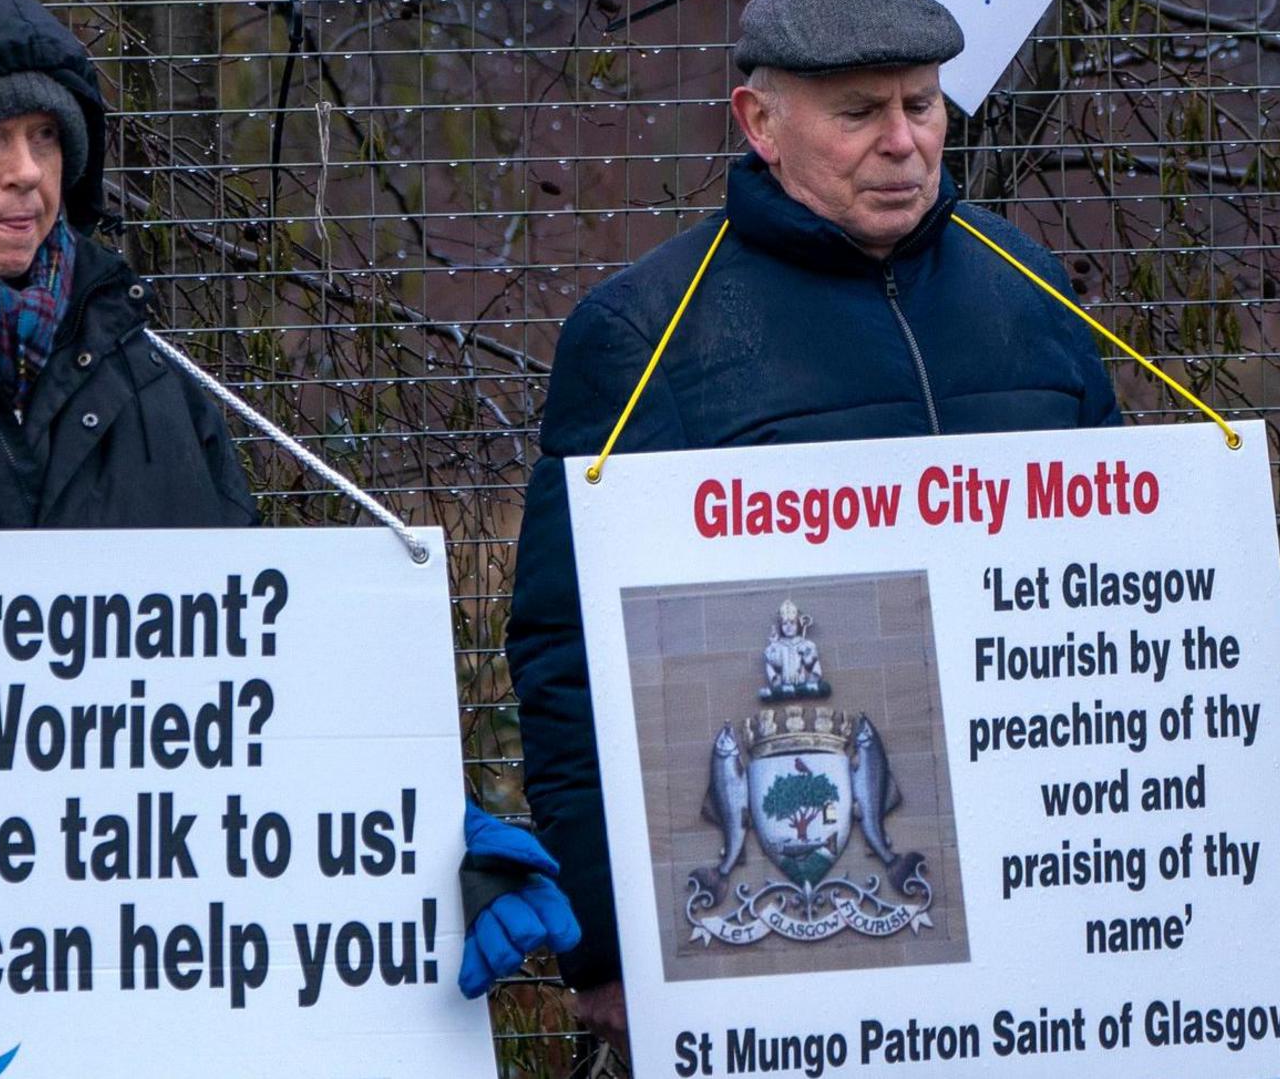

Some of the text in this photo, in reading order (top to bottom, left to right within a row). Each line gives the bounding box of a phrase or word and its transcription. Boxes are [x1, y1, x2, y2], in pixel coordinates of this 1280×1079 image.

[693, 460, 1160, 545] Glasgow City Motto
[983, 561, 1215, 613] ‘Let Glasgow
[974, 628, 1240, 683] Flourish by the
[968, 695, 1260, 762] preaching of thy
[1041, 764, 1206, 817] word and
[61, 791, 198, 881] talk
[221, 792, 292, 878] to
[318, 787, 418, 876] us!
[1001, 831, 1260, 900] praising of thy
[769, 912, 840, 938] GLASGOW
[839, 899, 912, 934] FLOURISH
[119, 901, 269, 1009] help
[293, 897, 439, 1008] you!
[674, 1030, 714, 1078] St
[725, 1026, 847, 1079] Mungo
[860, 1018, 980, 1065] Patron
[992, 1007, 1086, 1057] Saint
[1098, 1002, 1134, 1049] of
